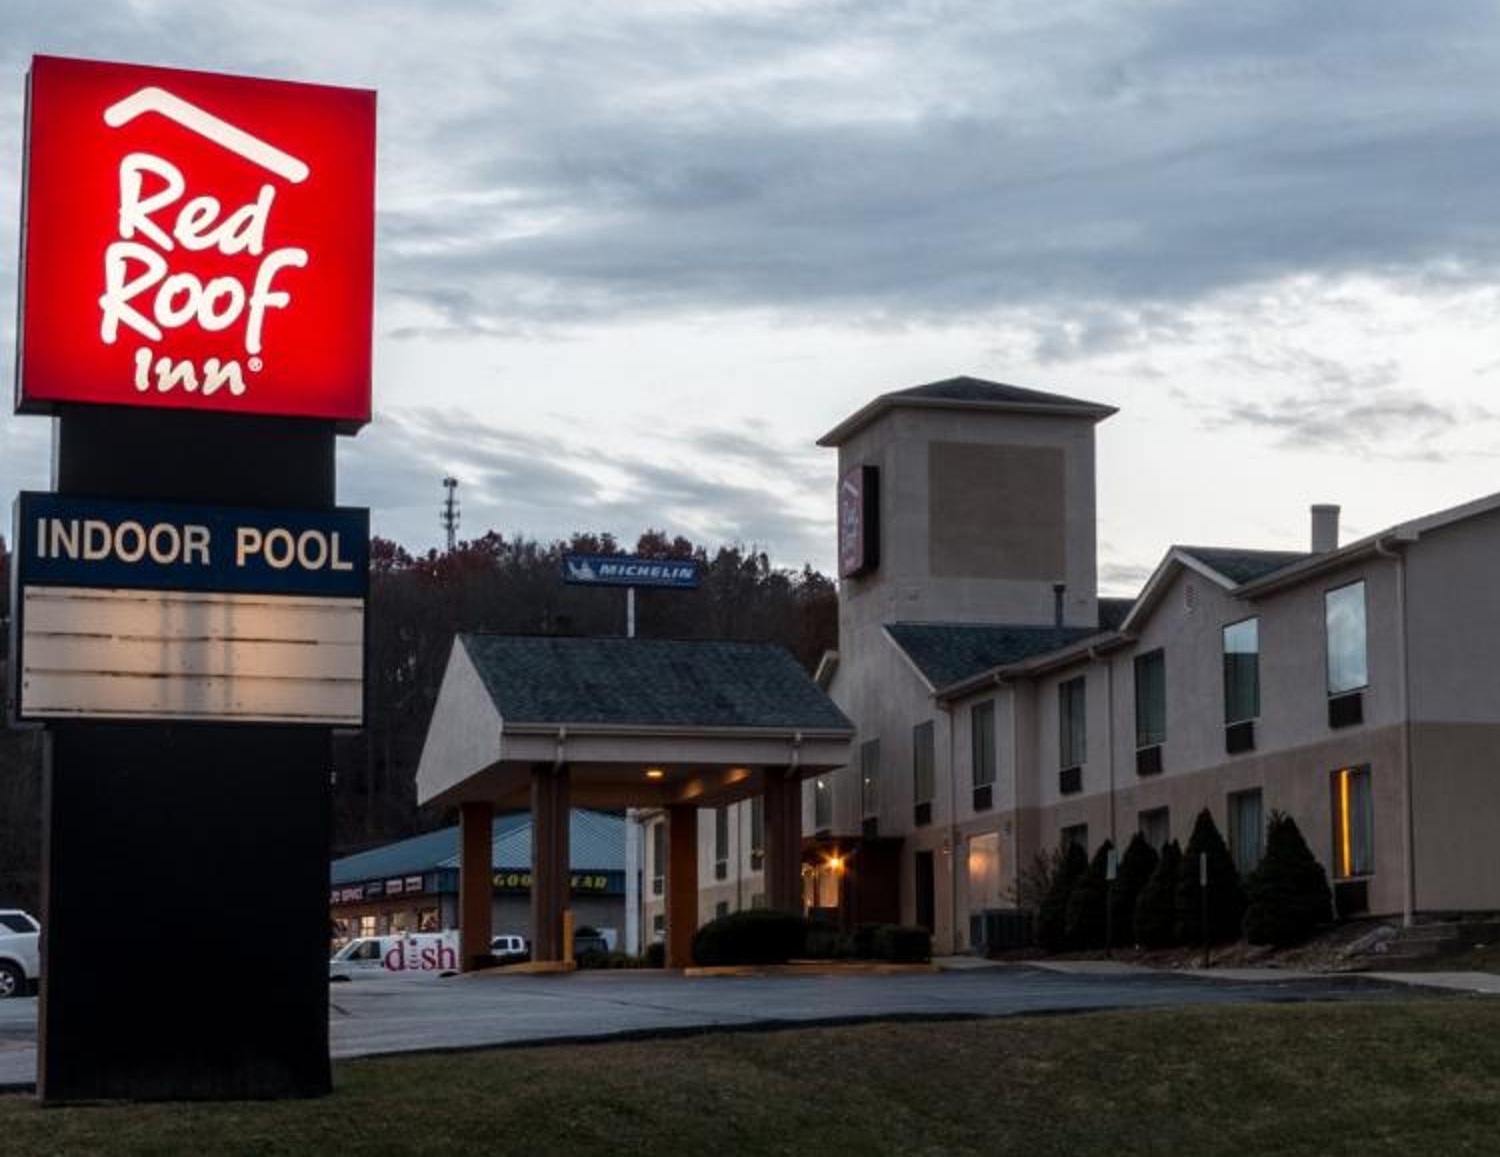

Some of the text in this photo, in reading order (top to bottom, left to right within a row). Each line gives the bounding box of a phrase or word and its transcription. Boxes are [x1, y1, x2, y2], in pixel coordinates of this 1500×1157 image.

[118, 152, 276, 256] Red
[99, 241, 308, 355] Roof
[36, 517, 354, 572] INDOOR POOL
[599, 563, 693, 579] MICHELIN
[492, 874, 608, 889] GOOEAR
[385, 938, 457, 971] dish
